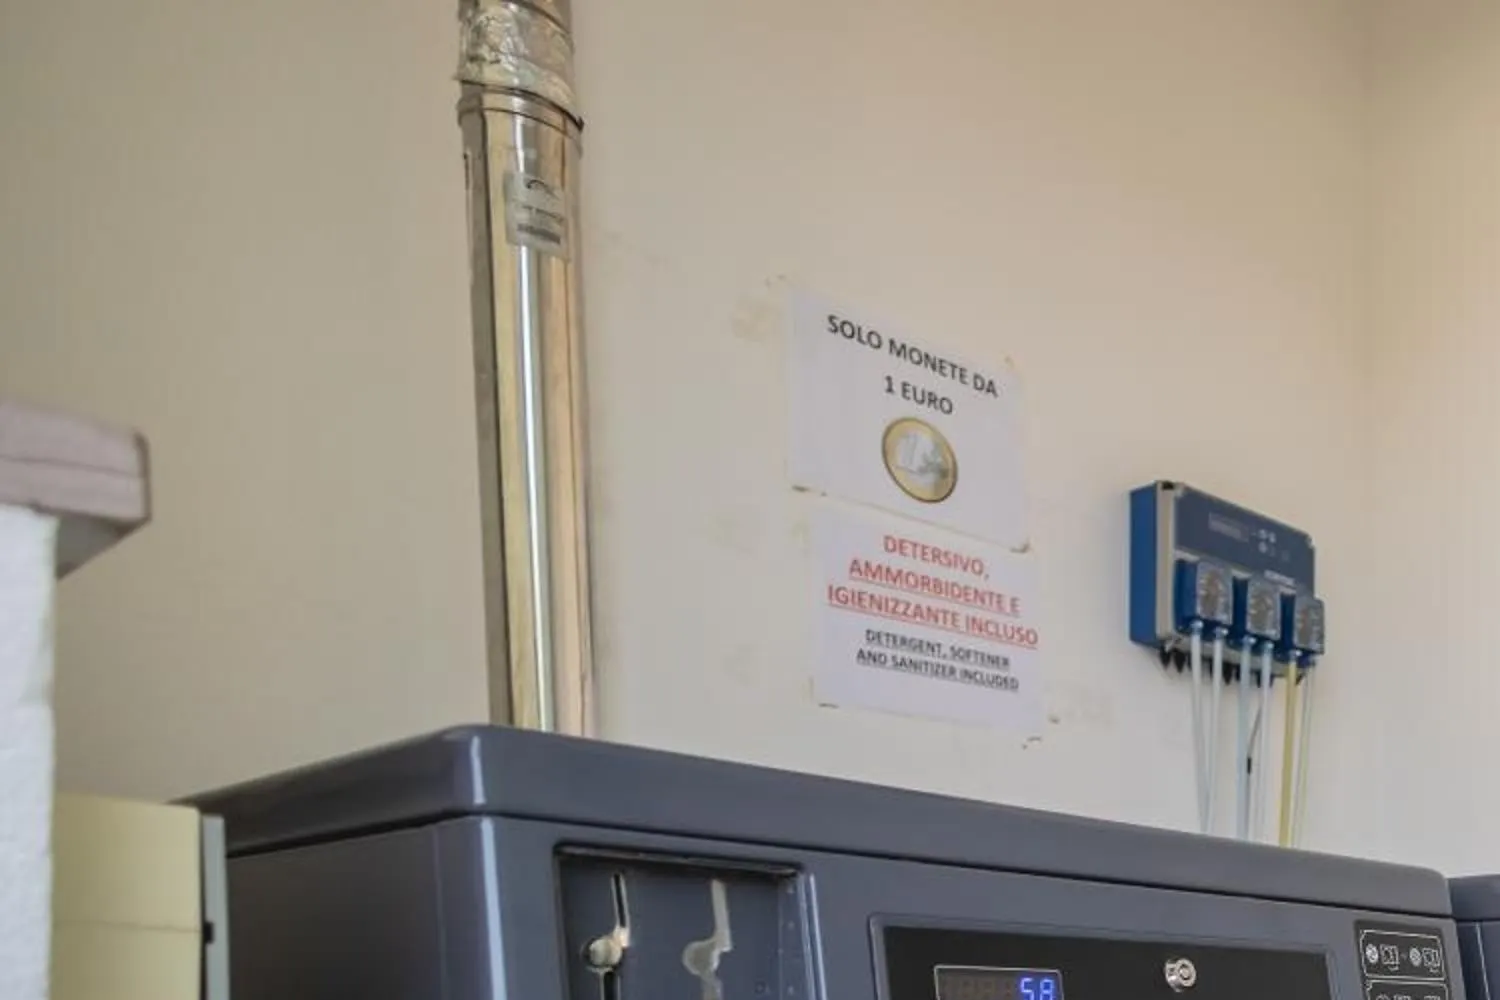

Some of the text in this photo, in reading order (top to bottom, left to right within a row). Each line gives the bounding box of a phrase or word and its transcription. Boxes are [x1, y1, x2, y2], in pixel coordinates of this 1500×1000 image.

[827, 314, 999, 398] SOLO MONETE DA
[884, 375, 954, 414] 1 EURO
[883, 535, 990, 580] DETERSIVO,
[849, 559, 1021, 614] AMMORBIDENTE E
[827, 585, 1039, 646] IGIENIZZANTE INCLUSO
[856, 648, 1020, 690] AND SANITIZER INCLUDED
[865, 629, 1011, 668] DETERGENT, SOFTENER
